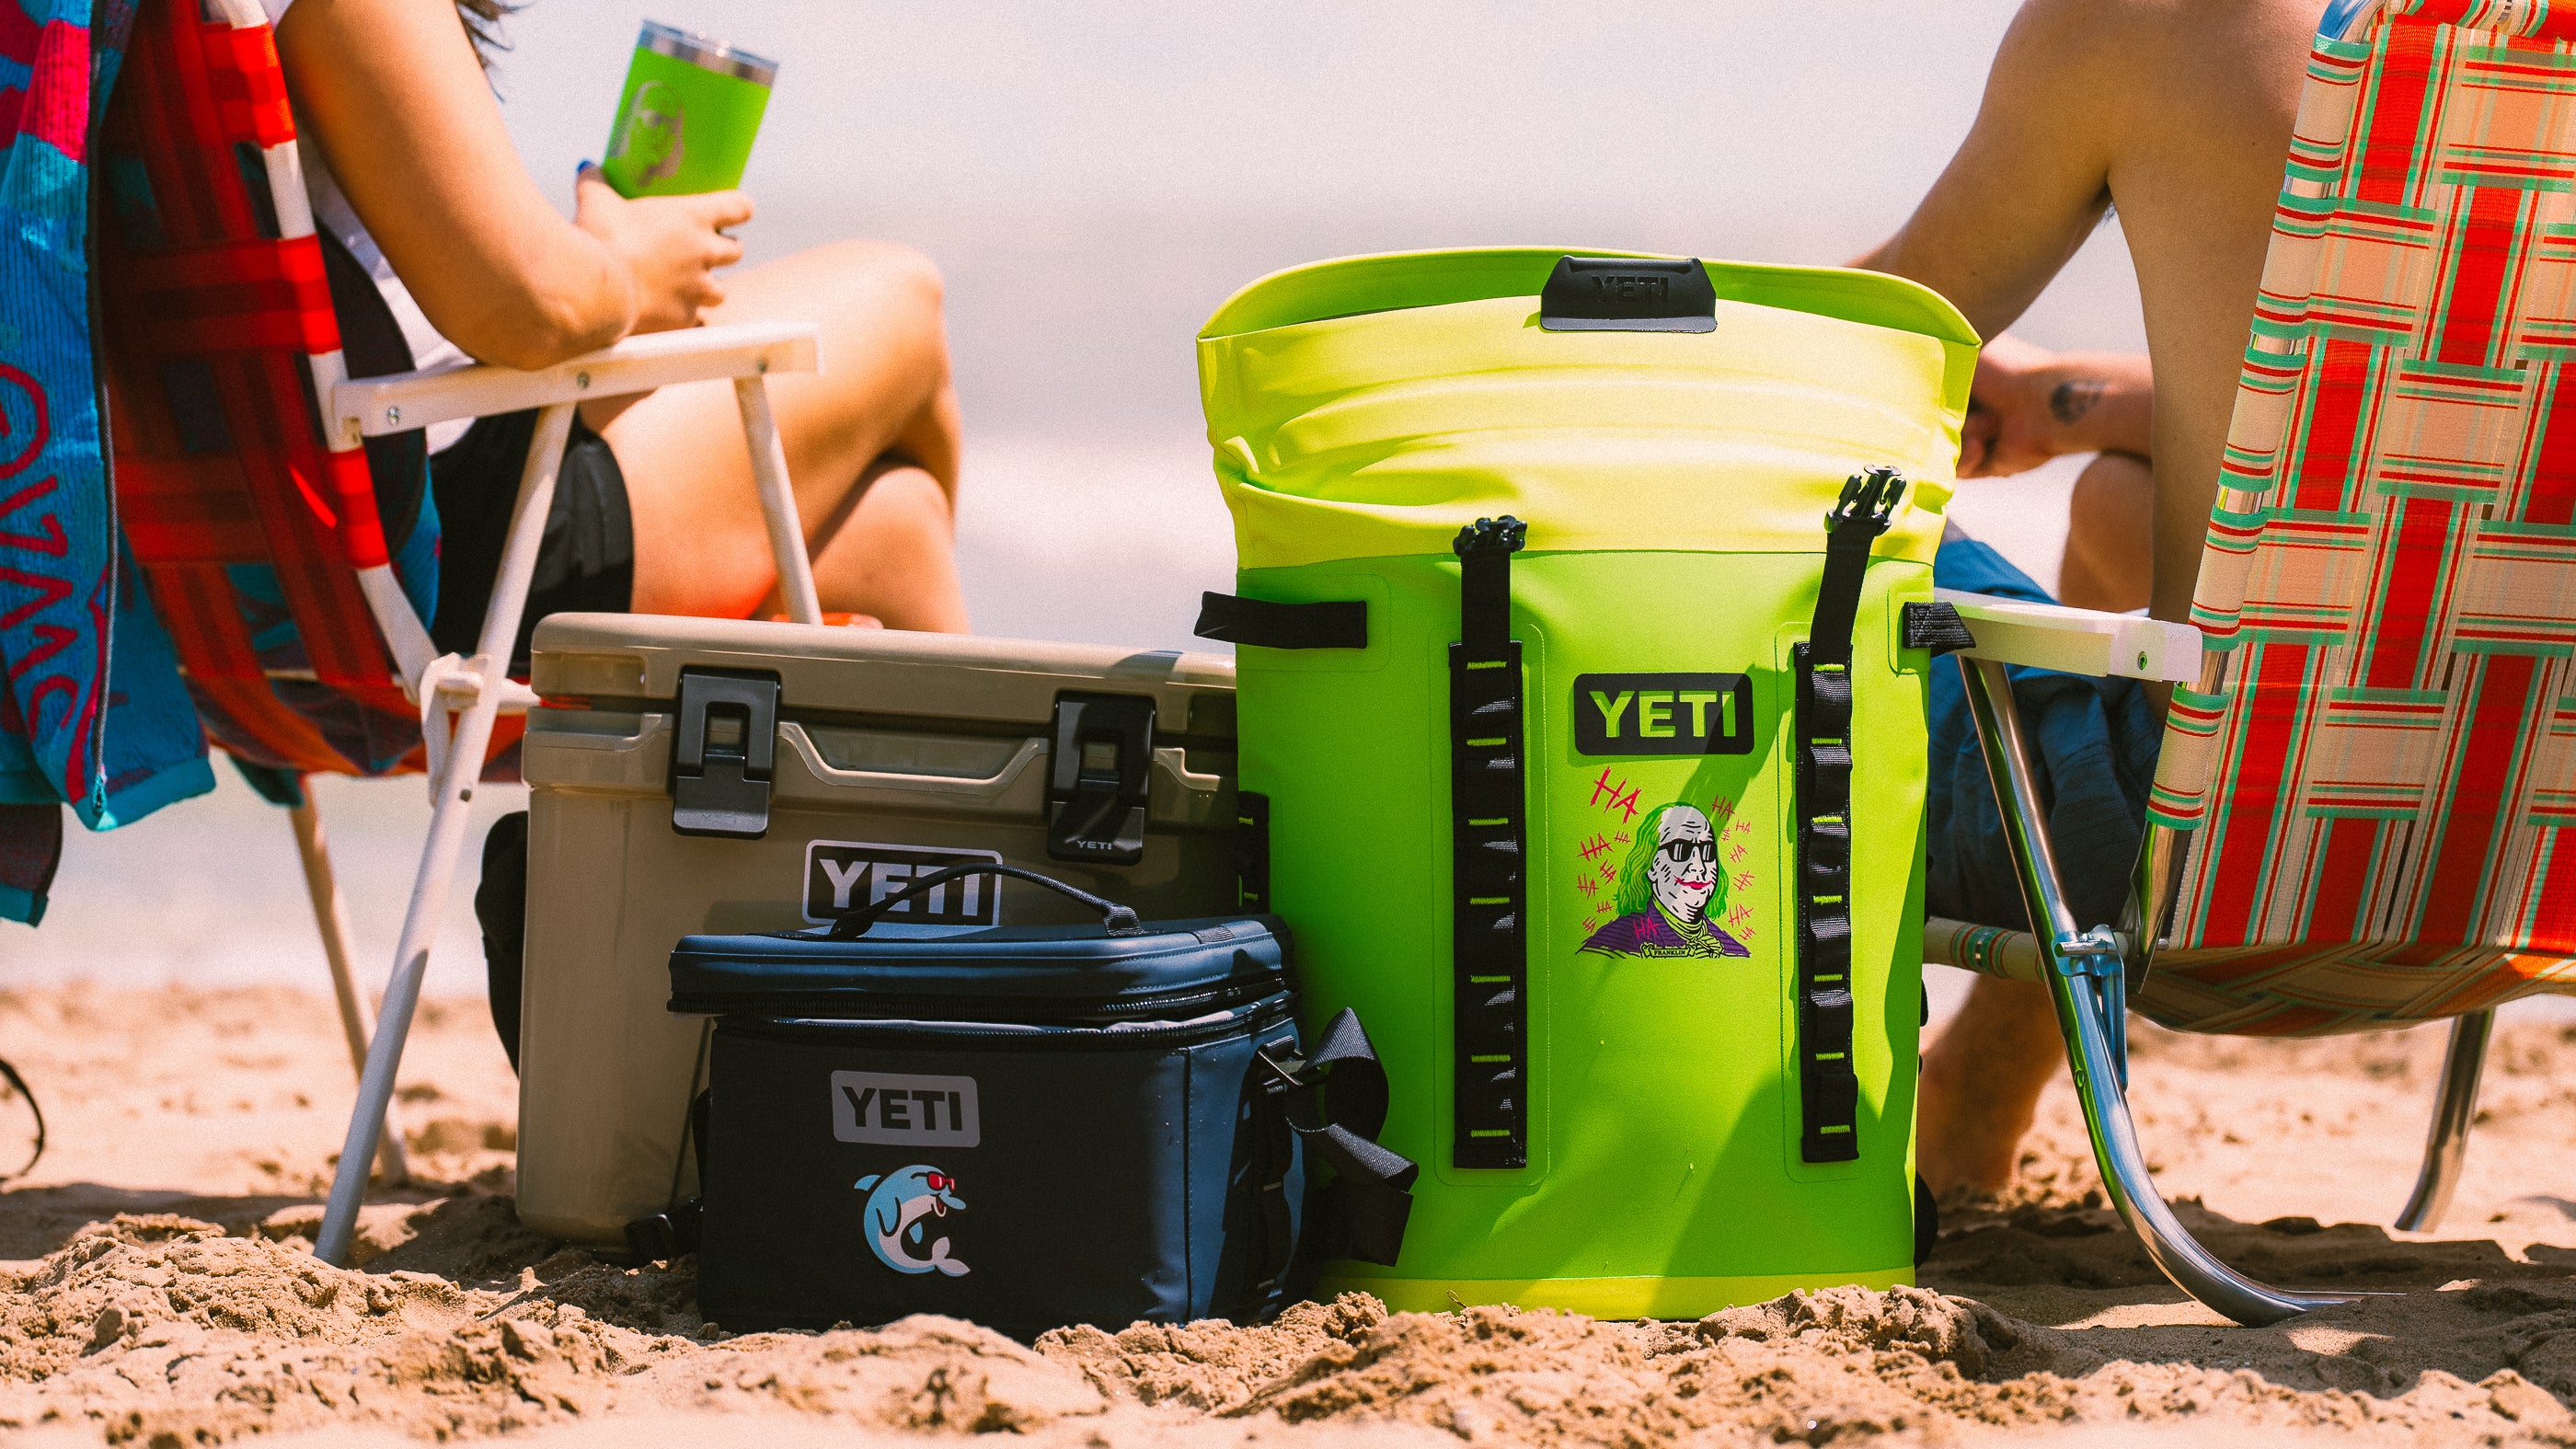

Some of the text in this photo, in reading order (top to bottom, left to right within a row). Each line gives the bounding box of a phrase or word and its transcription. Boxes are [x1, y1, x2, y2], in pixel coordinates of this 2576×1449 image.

[1592, 275, 1668, 304] YETI
[1589, 690, 1737, 738] YETI
[1590, 765, 1642, 824] HA
[1712, 795, 1735, 822] HA
[1614, 831, 1631, 845] HA
[1721, 827, 1731, 842] HA
[1736, 820, 1751, 834] HA
[1076, 840, 1112, 850] YETI
[1577, 832, 1615, 862] HA
[1730, 844, 1748, 863] HA
[1600, 858, 1616, 885] HA
[1733, 869, 1755, 892] HA
[819, 858, 982, 917] YETI
[1577, 872, 1600, 899] HA
[1597, 900, 1614, 914] HA
[1729, 903, 1754, 928] HA
[1633, 916, 1660, 939] HA
[1739, 926, 1757, 941] HA
[841, 1086, 963, 1132] YETI
